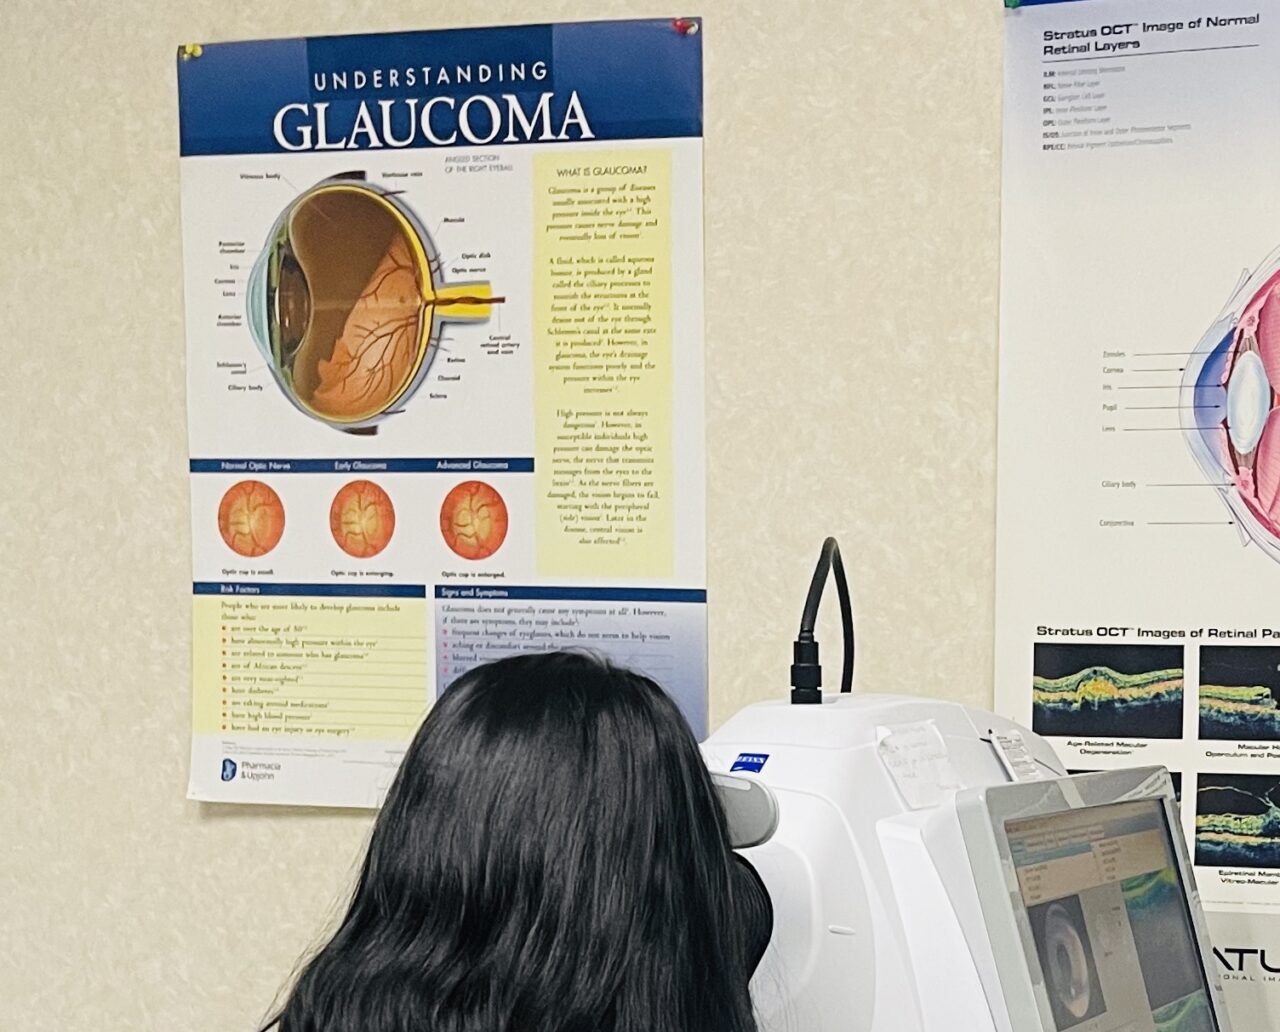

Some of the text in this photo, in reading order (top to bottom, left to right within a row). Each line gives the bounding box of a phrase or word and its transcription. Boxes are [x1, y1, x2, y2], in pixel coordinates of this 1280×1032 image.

[1044, 30, 1097, 41] Stratus
[1143, 22, 1183, 33] Image
[1188, 18, 1201, 29] of
[1207, 15, 1259, 28] Normal
[1044, 41, 1140, 55] Retinal Layers
[314, 61, 548, 93] UNDERSTANDING
[273, 90, 596, 151] GLAUCOMA
[557, 166, 647, 176] WHAT IS GLAUCOMA?
[249, 462, 267, 471] Optic
[335, 461, 387, 471] Early Glaucoma
[437, 461, 508, 469] Advanced Glaucoma
[442, 588, 459, 598] Signs
[476, 589, 508, 599] Symptoms
[632, 632, 646, 642] help
[1037, 626, 1093, 636] Stratus
[1138, 628, 1185, 639] Images
[1190, 629, 1203, 637] of
[1208, 629, 1257, 638] Retinal
[1206, 751, 1248, 759] Operculum
[242, 762, 281, 770] Pharmacia
[247, 772, 274, 781] Upjohn
